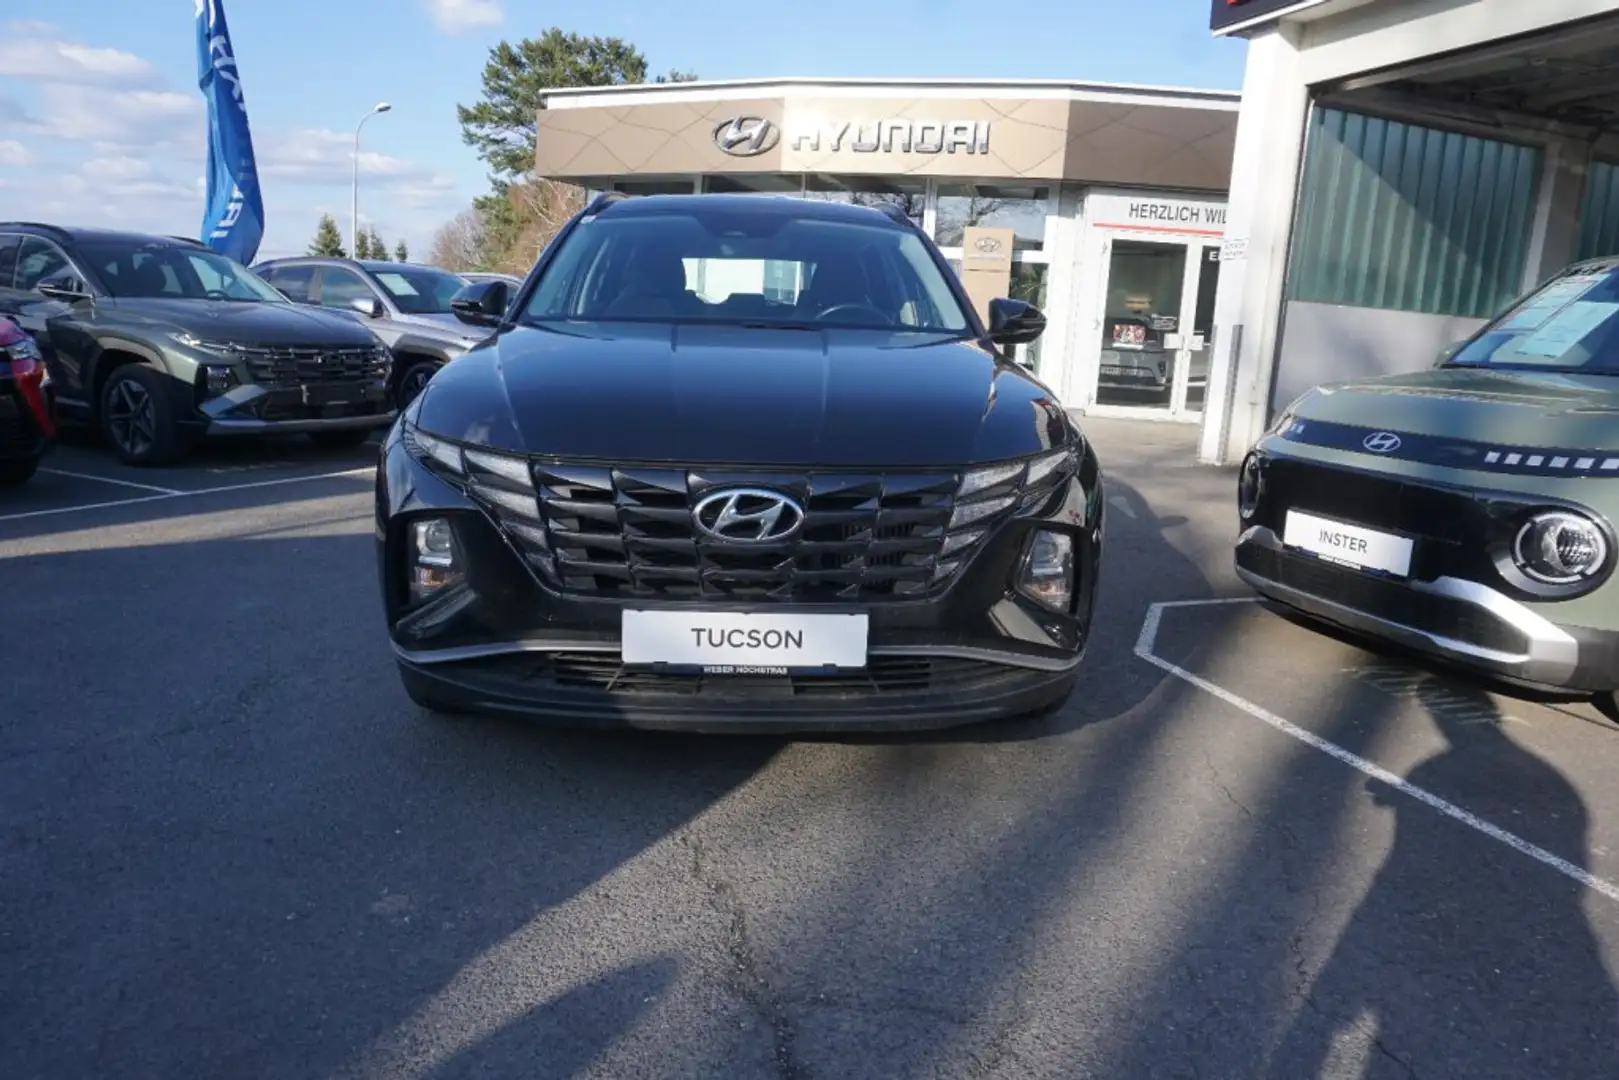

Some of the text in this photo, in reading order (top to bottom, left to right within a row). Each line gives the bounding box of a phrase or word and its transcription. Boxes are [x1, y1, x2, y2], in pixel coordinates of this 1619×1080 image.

[791, 119, 991, 155] HYUNDAI
[1128, 202, 1200, 223] HERZLICH
[1319, 527, 1368, 553] INSTER
[690, 627, 803, 649] TUCSON
[703, 665, 734, 674] WEBER
